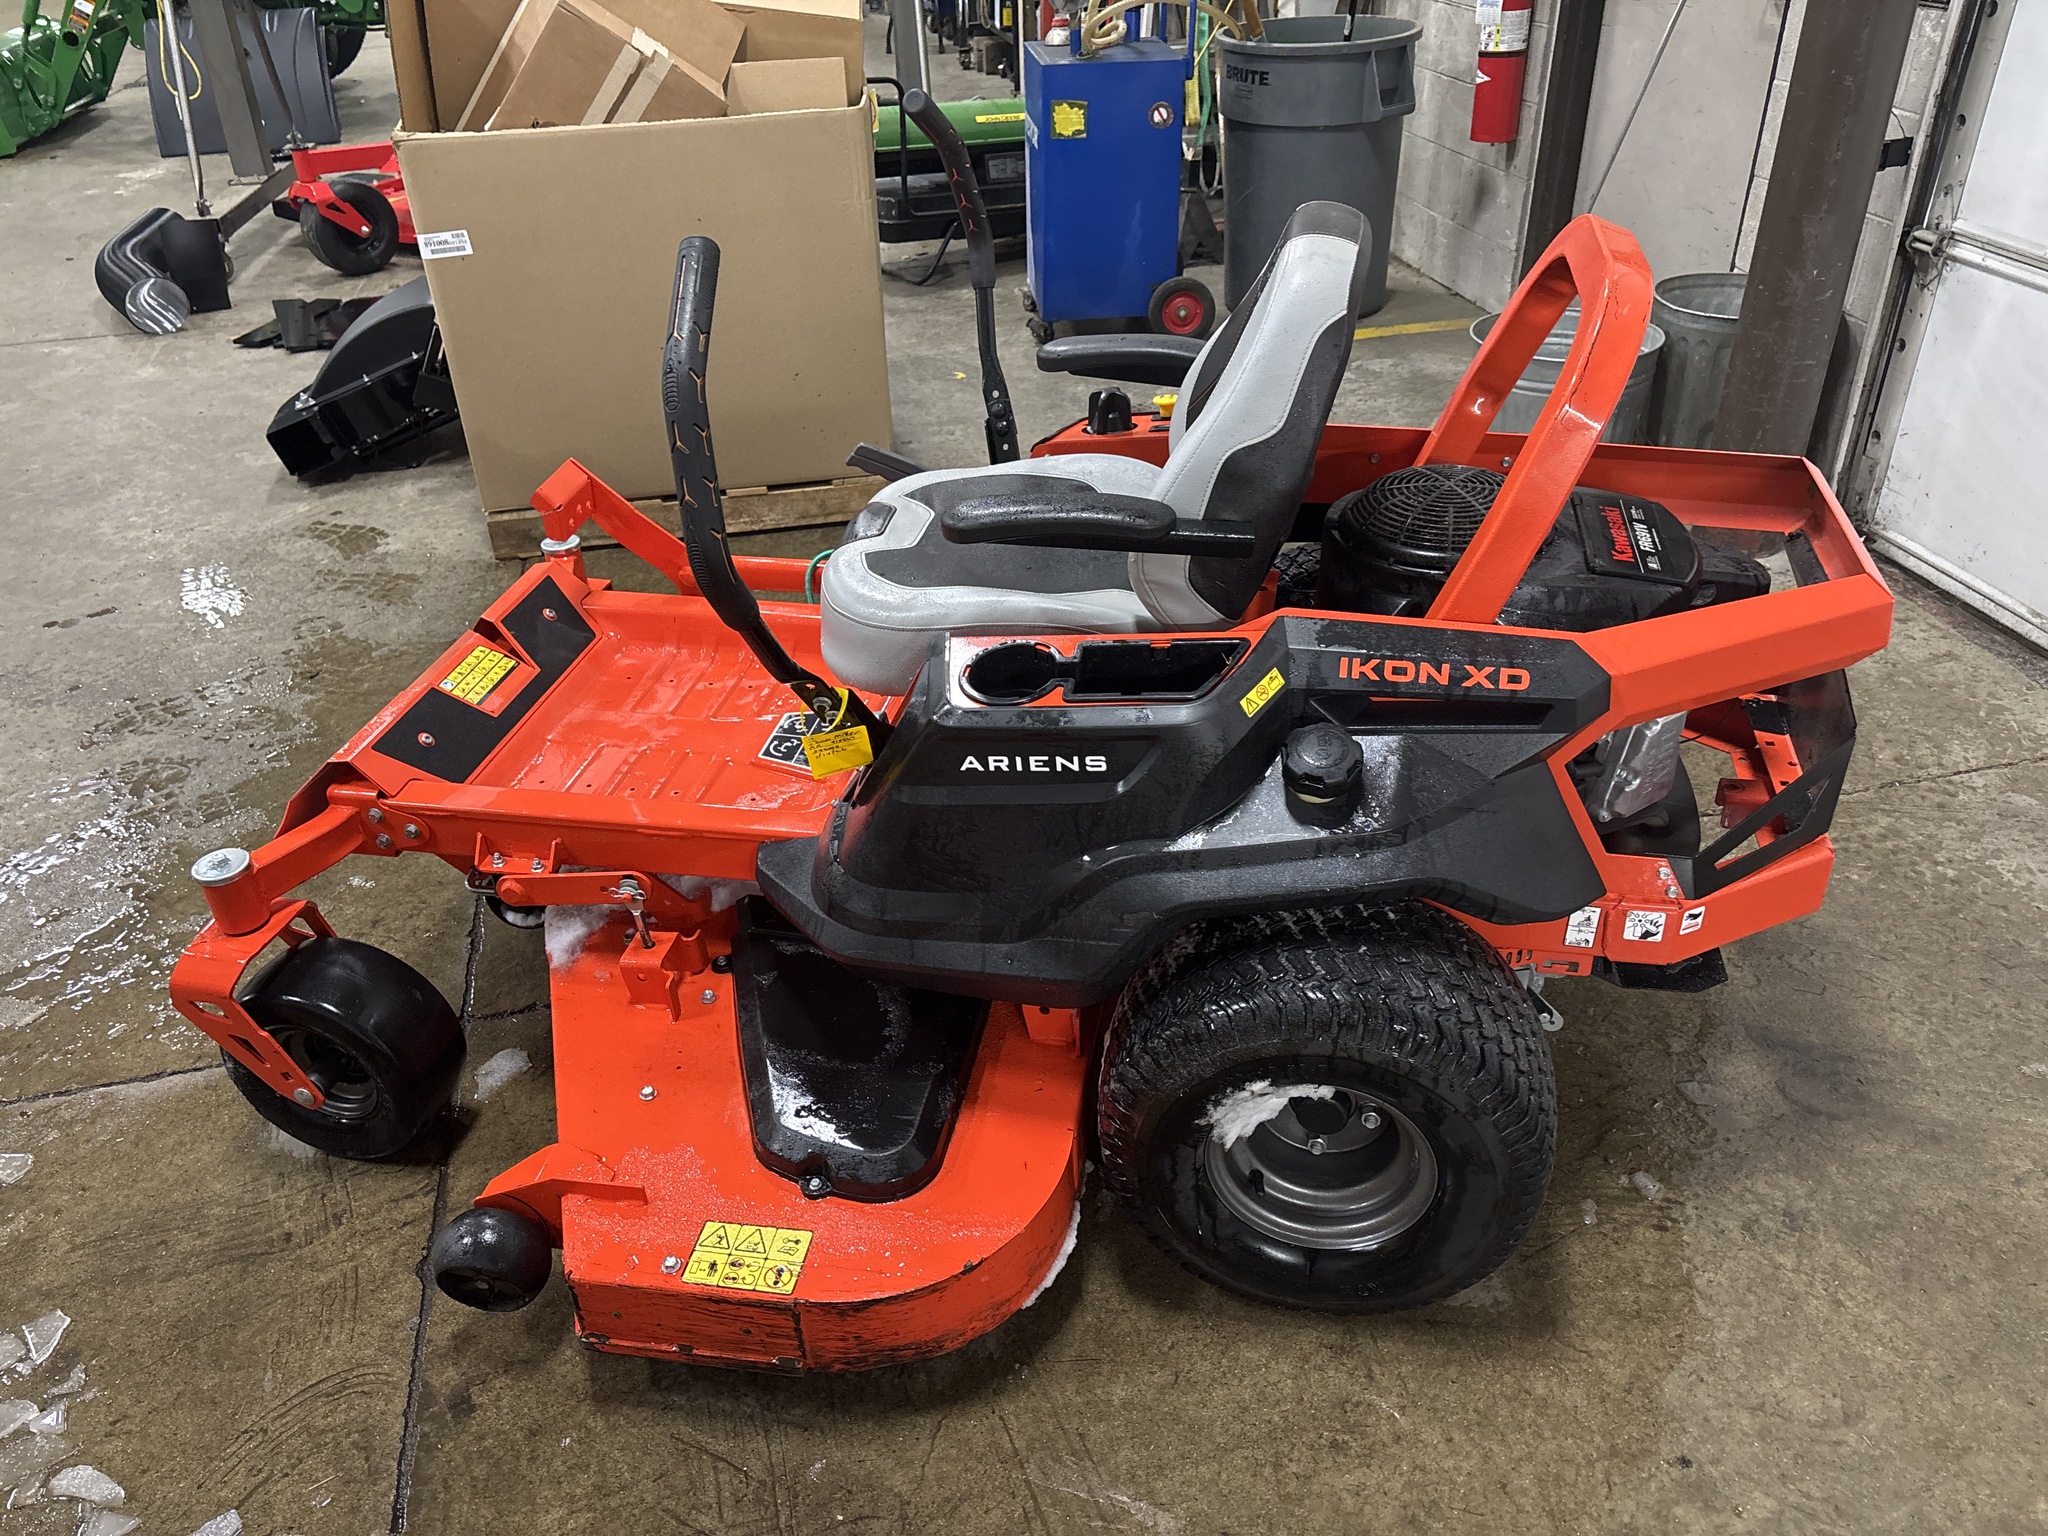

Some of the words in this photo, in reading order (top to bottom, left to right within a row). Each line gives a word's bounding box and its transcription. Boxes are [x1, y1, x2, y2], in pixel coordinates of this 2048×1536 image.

[1226, 64, 1269, 86] BRUTE
[1599, 505, 1635, 562] Kawasaki
[1632, 521, 1656, 553] FR691V
[1339, 657, 1450, 685] IKON
[1461, 665, 1530, 691] XD
[960, 755, 1107, 772] ARIENS
